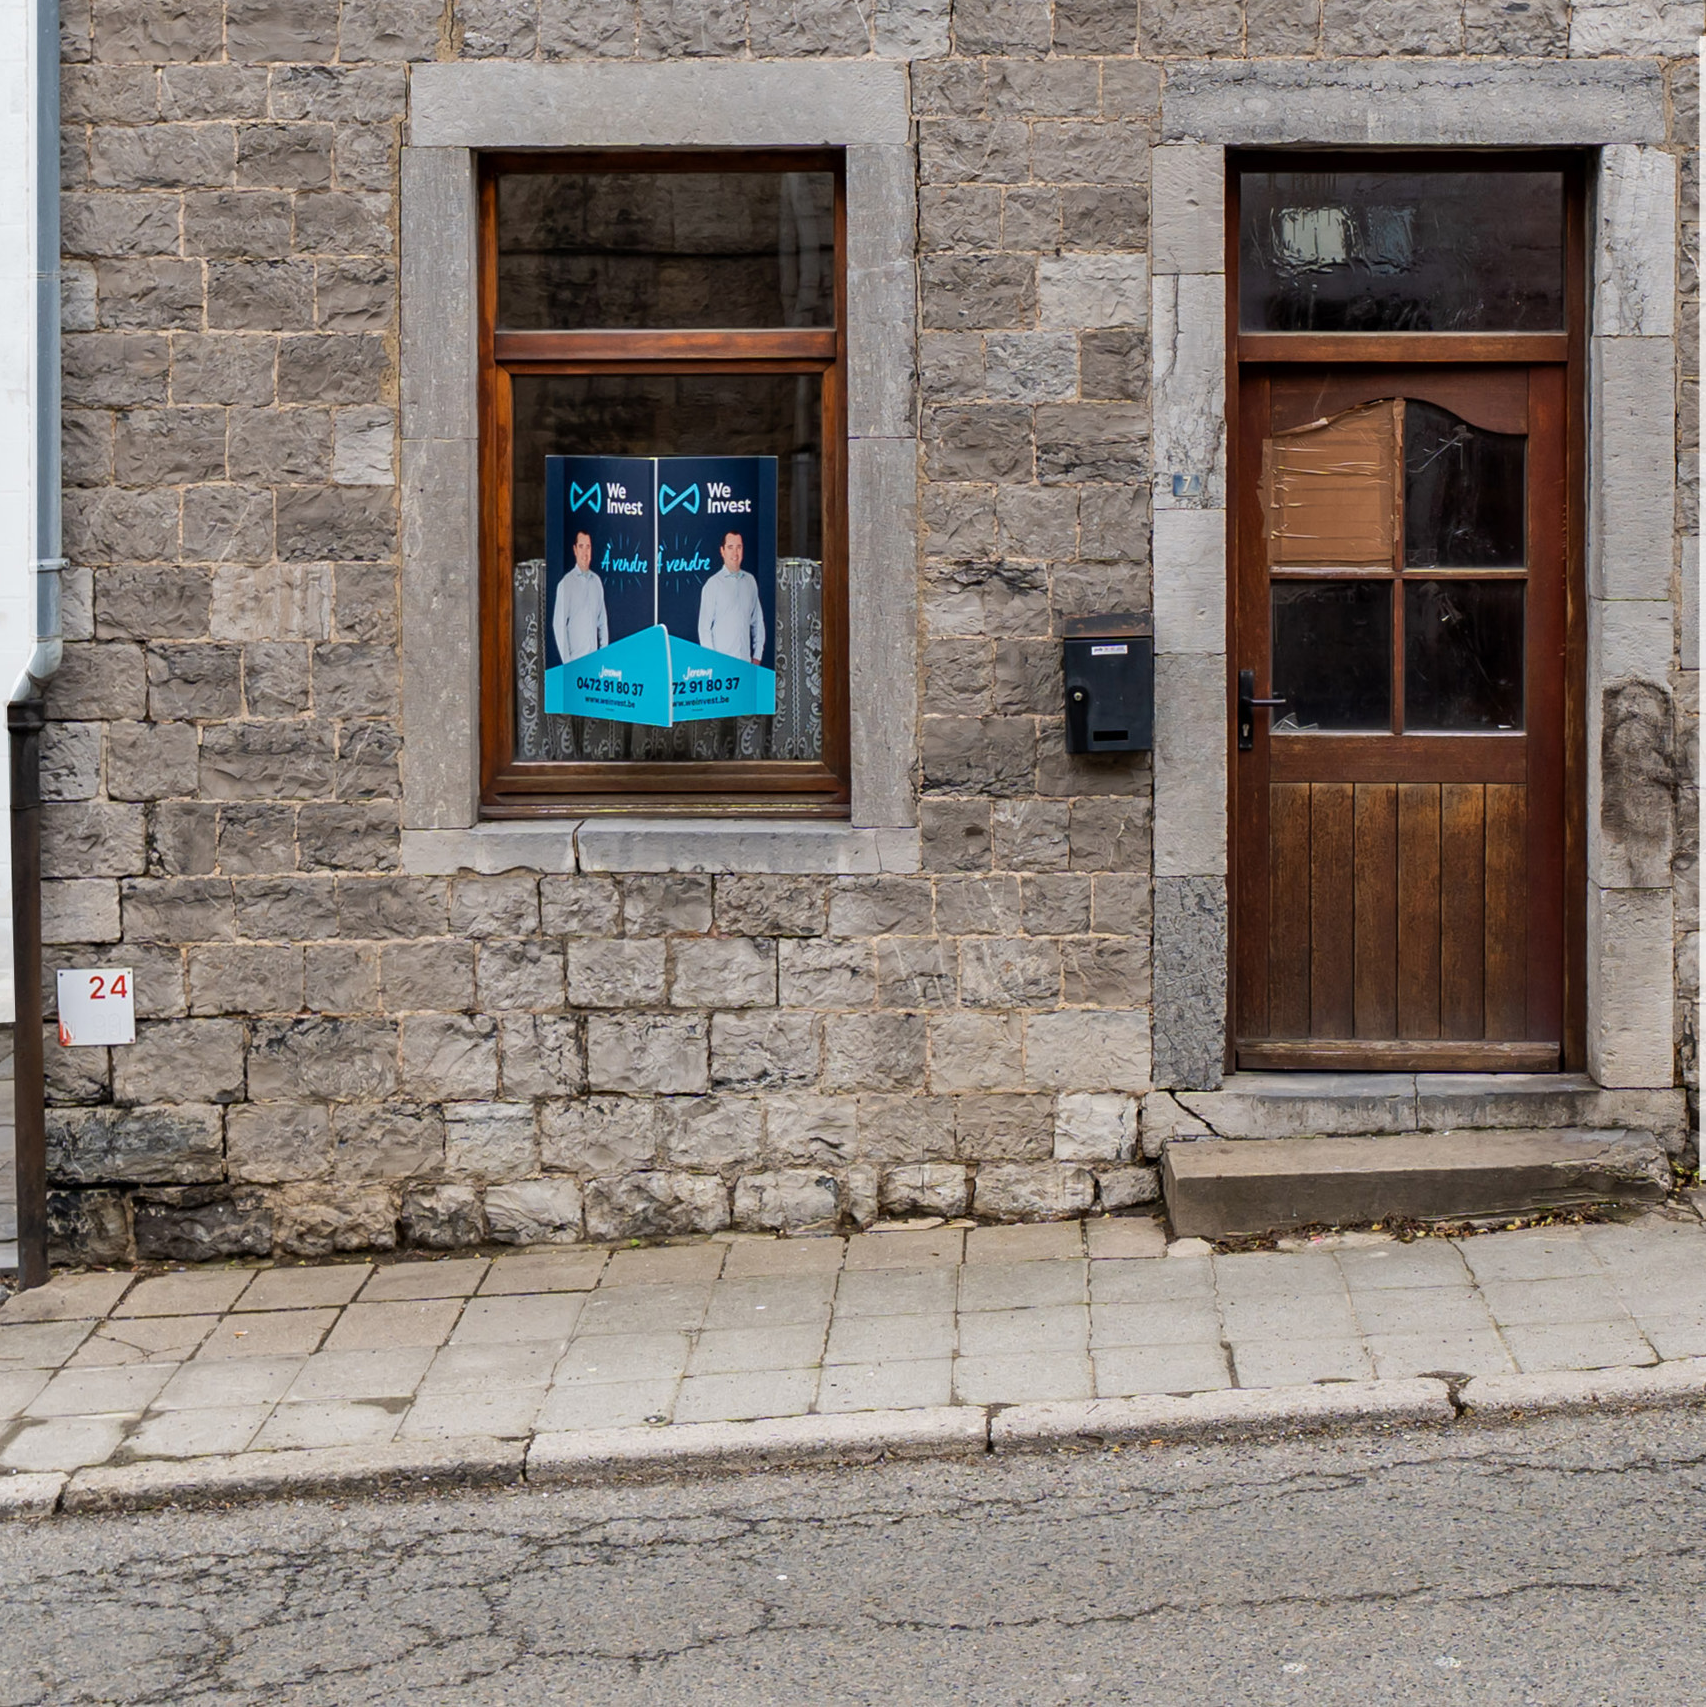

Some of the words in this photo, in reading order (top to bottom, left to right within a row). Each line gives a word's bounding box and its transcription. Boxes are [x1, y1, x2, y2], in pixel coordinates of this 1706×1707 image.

[606, 482, 627, 499] We
[707, 482, 732, 498] We
[1182, 475, 1191, 493] 7
[606, 498, 643, 516] Invest
[707, 498, 752, 514] Invest
[601, 543, 611, 572] À
[612, 553, 648, 574] vendre
[666, 551, 711, 573] vendre
[577, 676, 601, 691] 0472
[603, 679, 614, 693] 91
[616, 681, 630, 695] 80
[631, 683, 644, 697] 37
[672, 681, 686, 695] 72
[689, 680, 703, 694] 91
[706, 678, 723, 692] 80
[725, 677, 740, 691] 37
[672, 695, 730, 707] ww.weinvest.be
[89, 974, 127, 1000] 24
